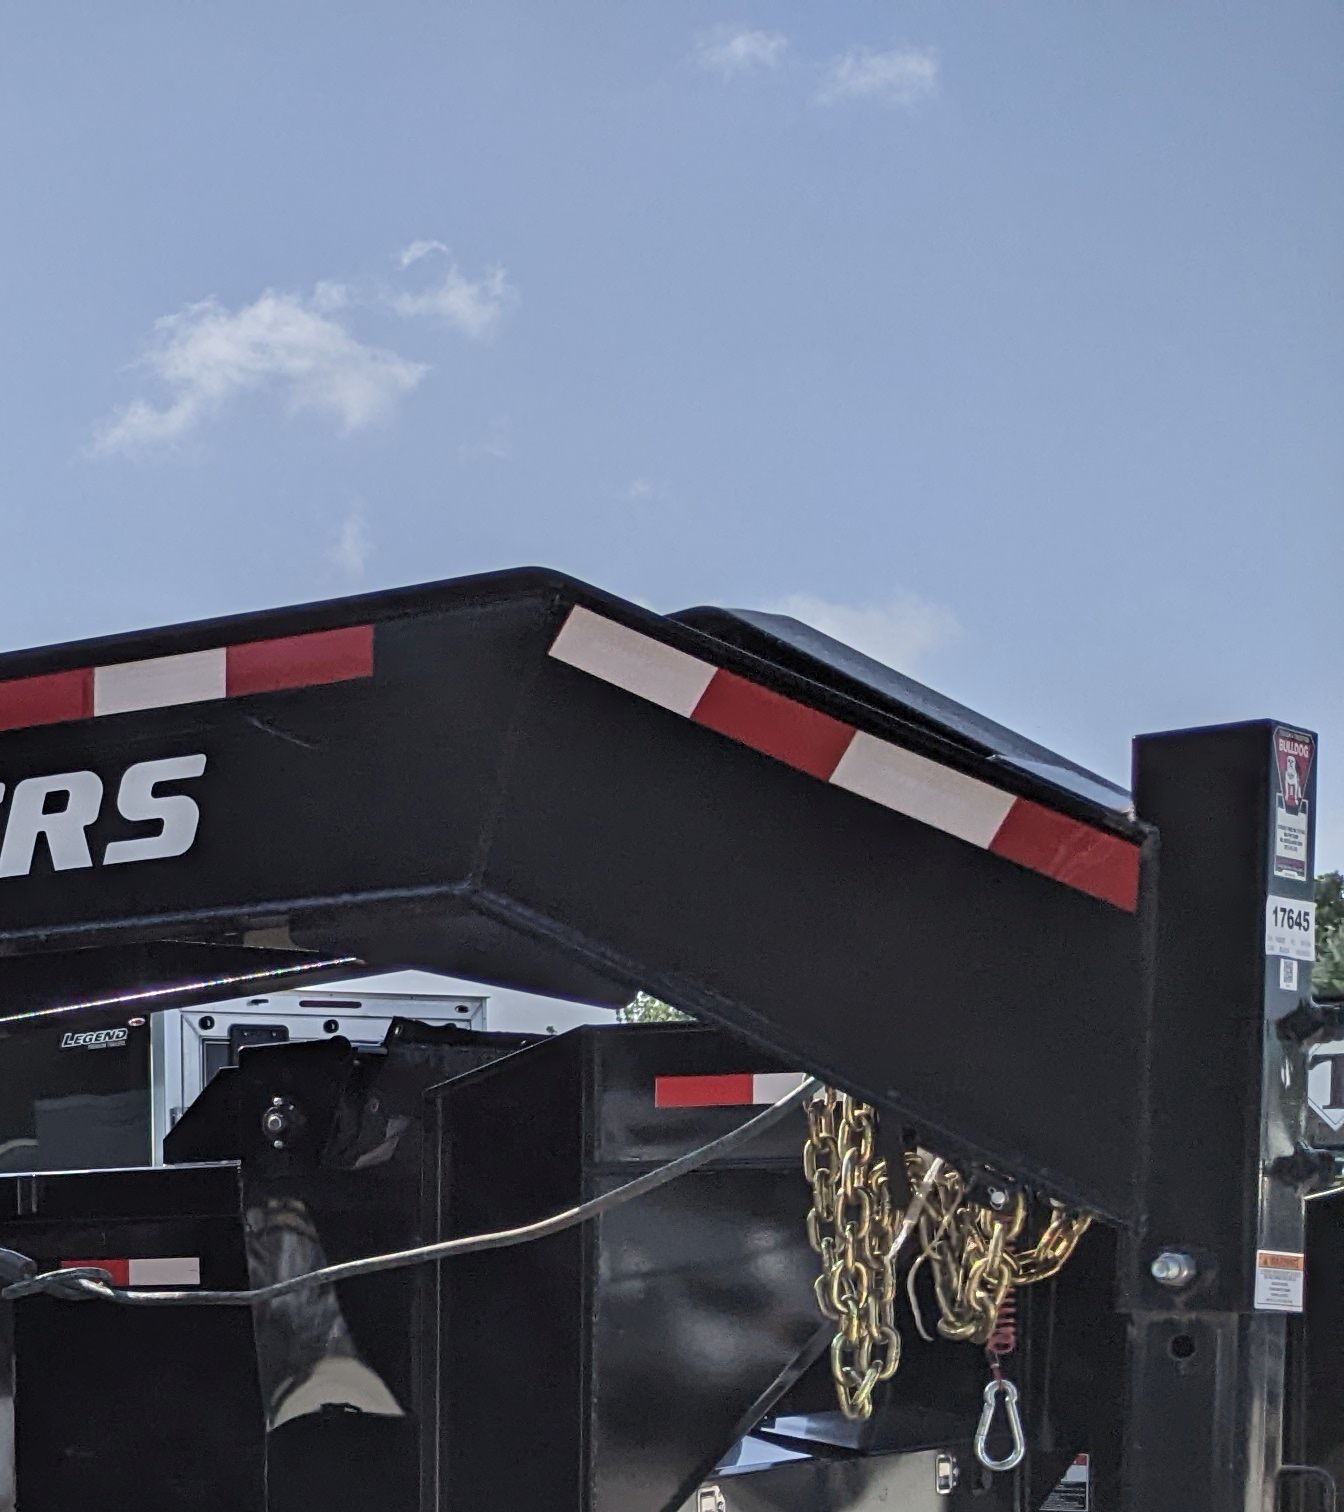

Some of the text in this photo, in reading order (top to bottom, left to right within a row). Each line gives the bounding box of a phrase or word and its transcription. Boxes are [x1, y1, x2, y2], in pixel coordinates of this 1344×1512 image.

[1279, 738, 1309, 758] BULLDOG
[1273, 905, 1310, 932] 17645
[62, 1028, 128, 1048] LEGEND
